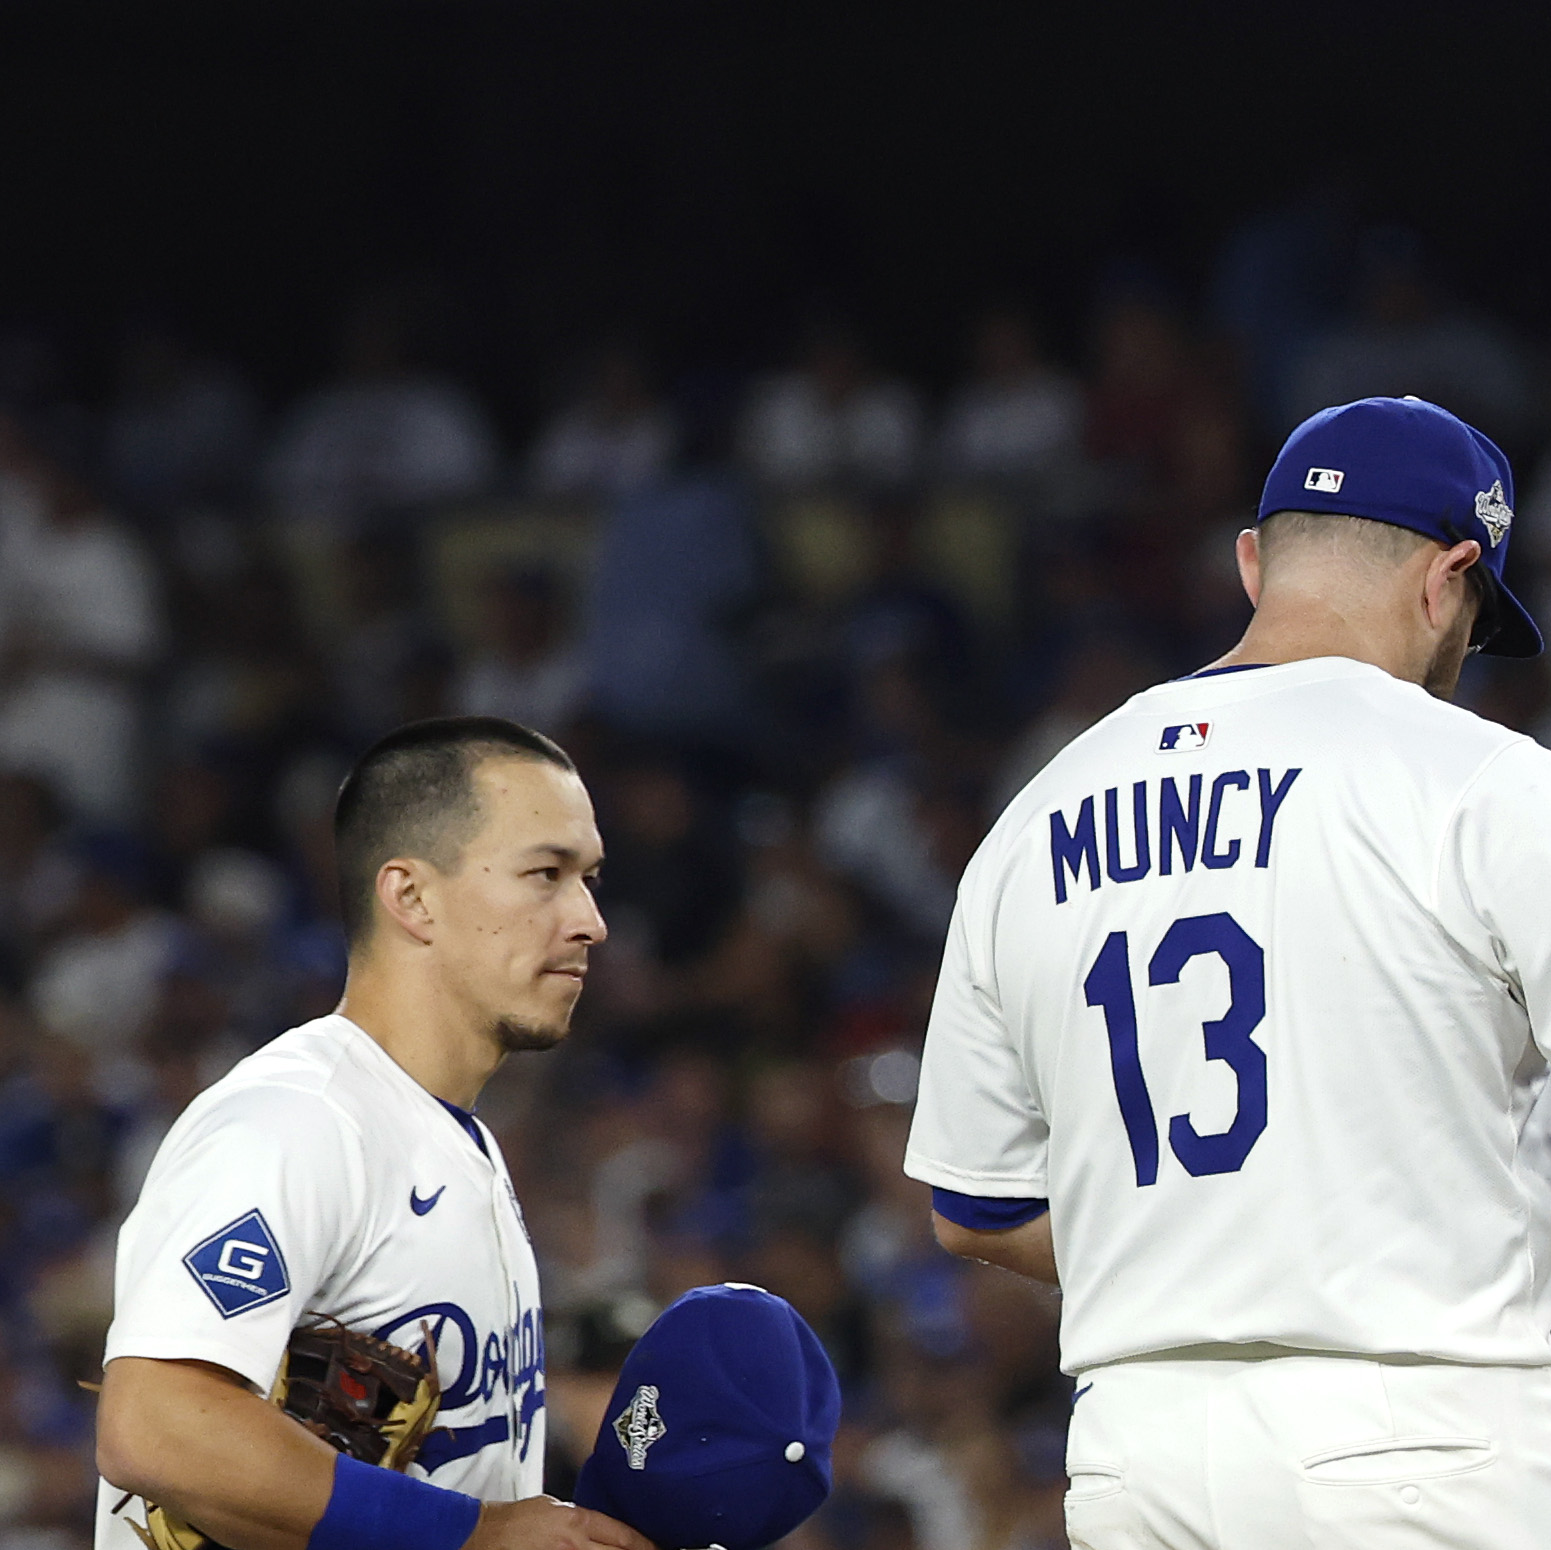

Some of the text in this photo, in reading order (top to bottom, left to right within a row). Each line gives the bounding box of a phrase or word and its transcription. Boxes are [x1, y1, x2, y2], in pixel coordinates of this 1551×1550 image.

[1049, 768, 1303, 905] MUNCY
[1083, 911, 1268, 1187] 13
[217, 1239, 270, 1280] G
[373, 1282, 547, 1465] Dodg
